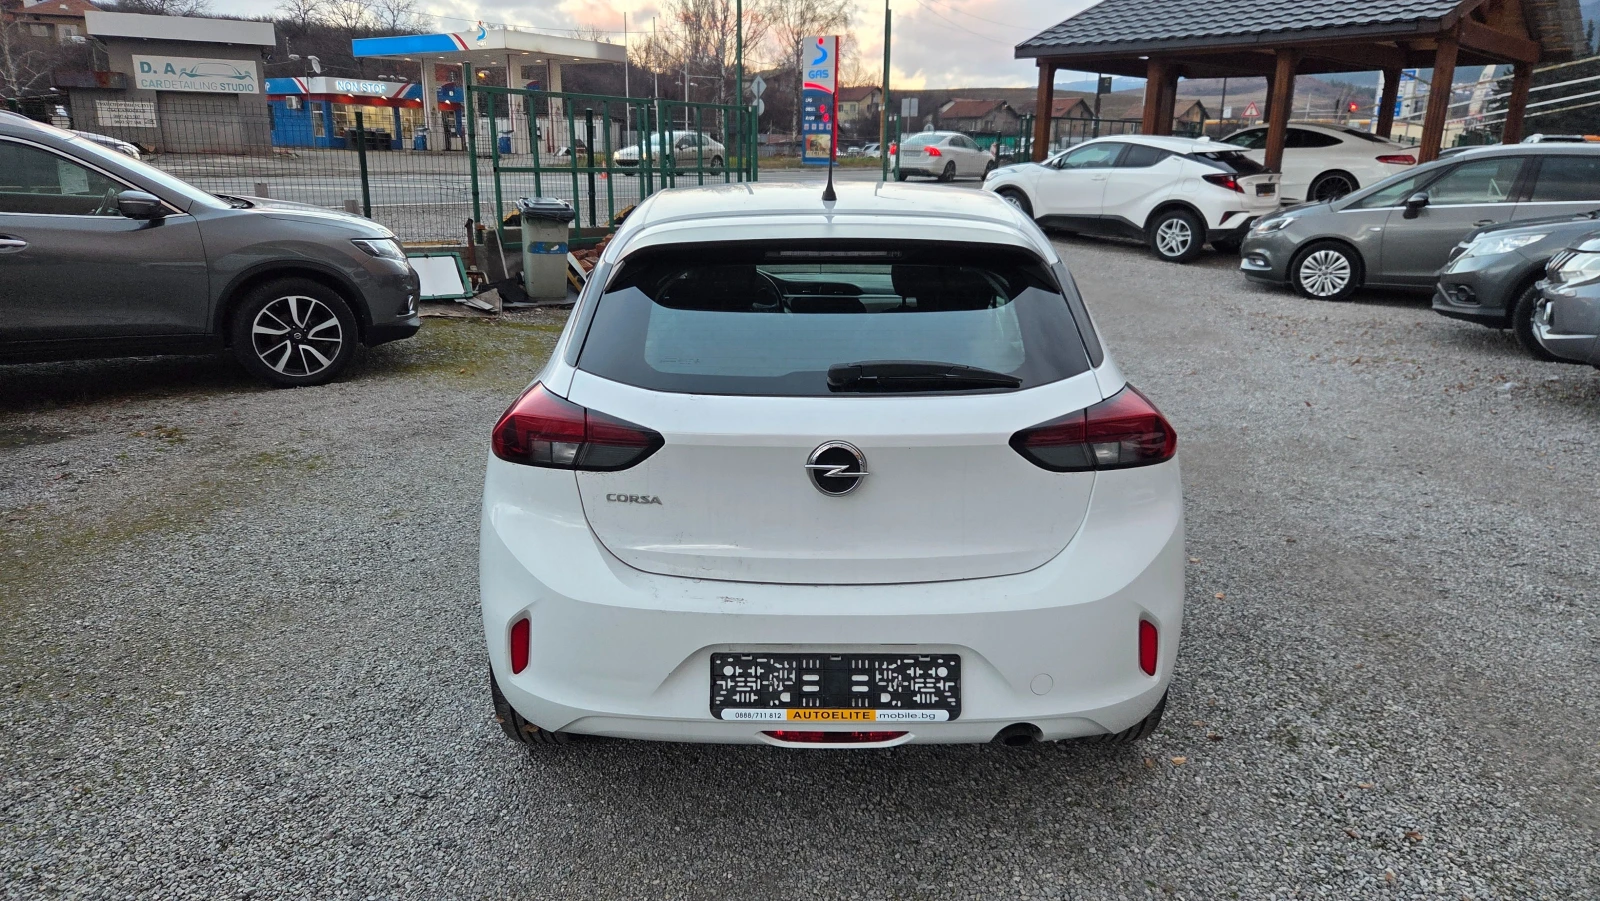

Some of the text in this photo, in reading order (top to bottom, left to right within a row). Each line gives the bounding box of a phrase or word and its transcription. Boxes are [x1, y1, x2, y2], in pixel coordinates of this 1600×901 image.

[164, 62, 176, 75] A
[808, 69, 829, 79] GAS
[141, 79, 218, 91] CARDETAILING
[219, 83, 254, 92] STUDIO
[336, 80, 386, 94] NON STOP
[606, 493, 663, 506] CORSA
[793, 711, 871, 719] AUTOELITE
